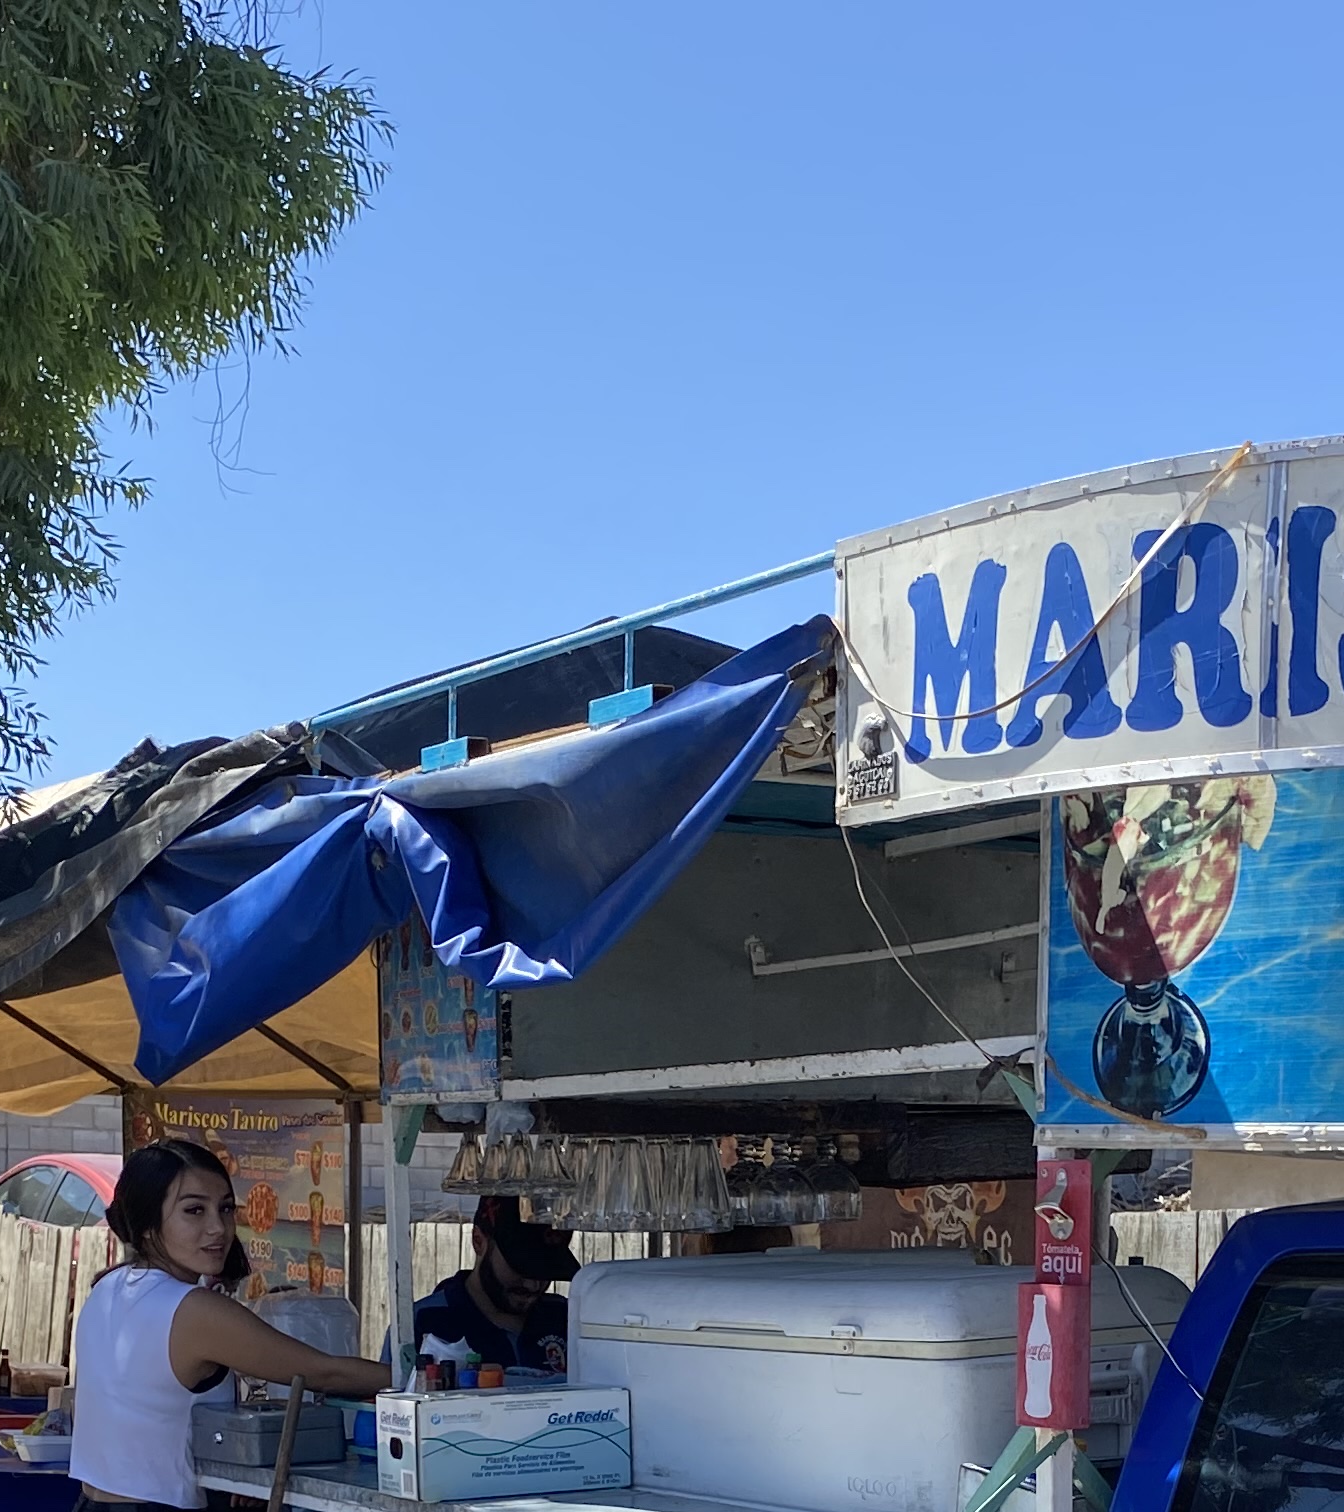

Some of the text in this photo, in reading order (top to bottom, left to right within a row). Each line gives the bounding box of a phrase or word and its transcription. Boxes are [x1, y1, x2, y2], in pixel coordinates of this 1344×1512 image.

[154, 1103, 228, 1130] Mariscos
[230, 1108, 279, 1132] Taviro
[250, 1240, 272, 1258] $190
[1042, 1252, 1083, 1280] aquí
[548, 1412, 574, 1425] Get
